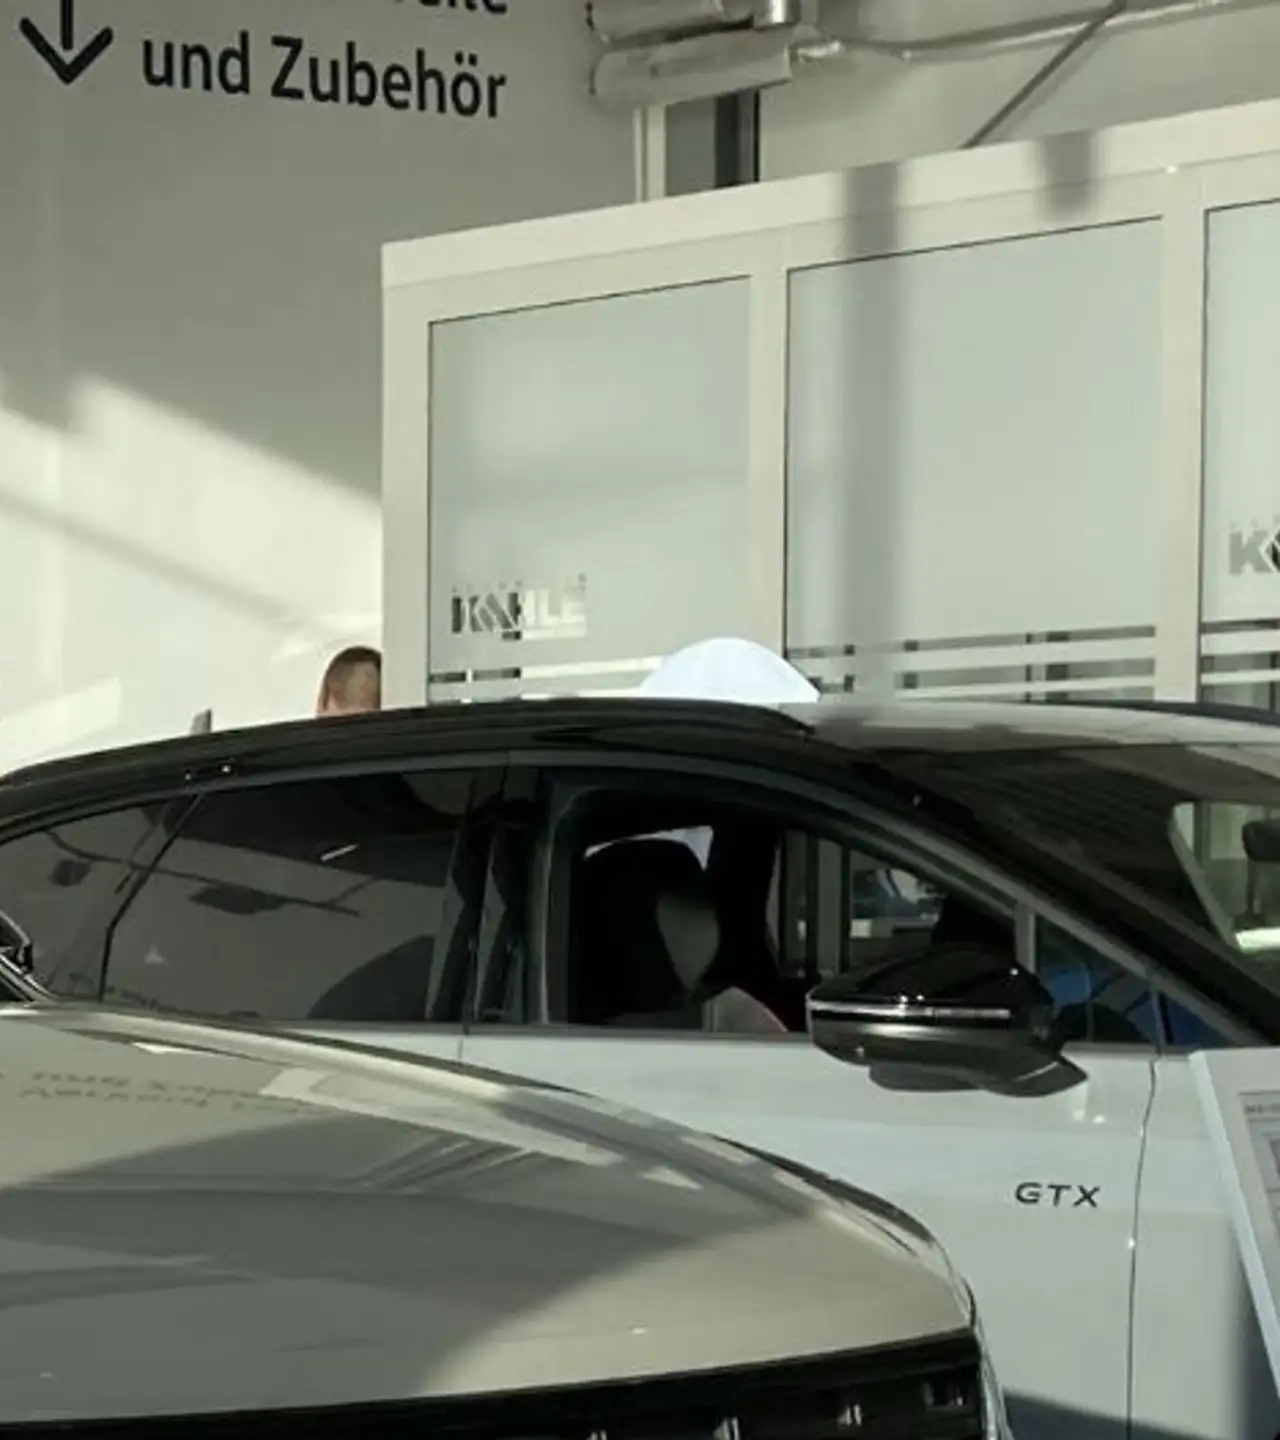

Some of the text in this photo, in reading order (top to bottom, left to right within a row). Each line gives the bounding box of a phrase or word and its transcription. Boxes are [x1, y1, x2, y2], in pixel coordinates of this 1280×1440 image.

[141, 31, 507, 119] und Zubehör
[1014, 1181, 1101, 1208] GTX
